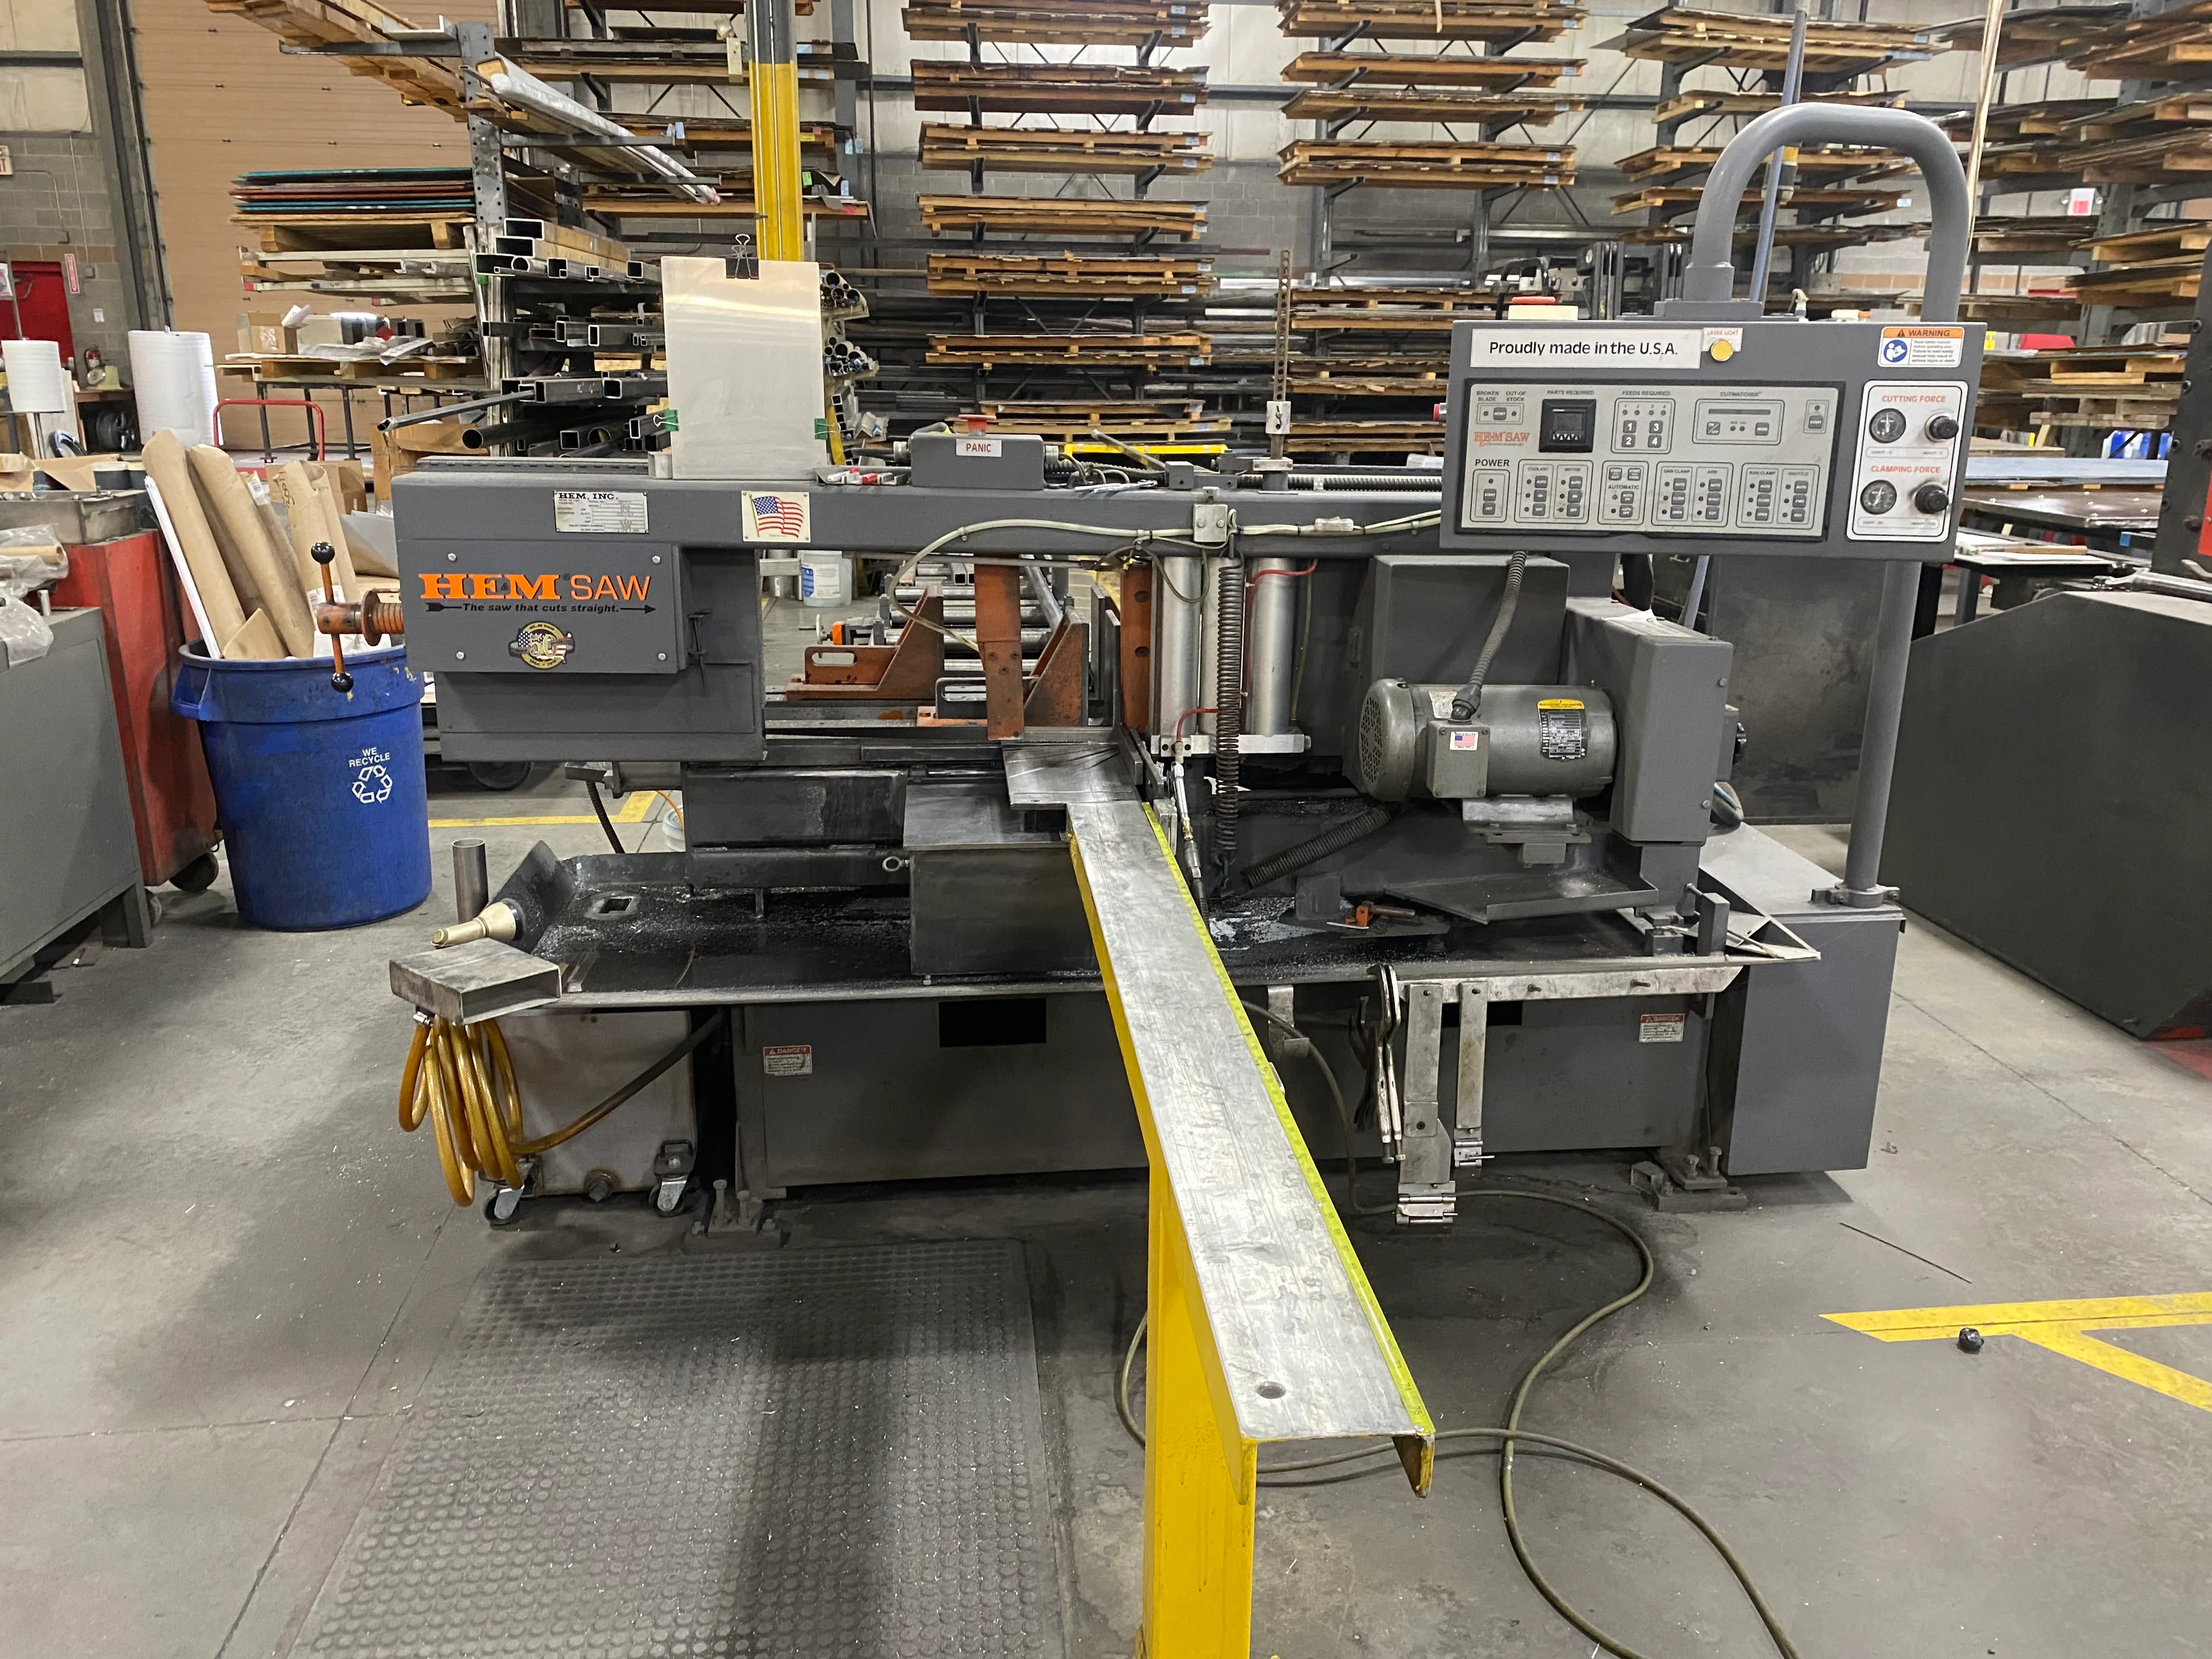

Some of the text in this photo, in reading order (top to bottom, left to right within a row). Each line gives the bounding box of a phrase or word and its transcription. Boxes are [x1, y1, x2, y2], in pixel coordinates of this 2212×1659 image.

[1489, 341, 1678, 356] Proudly made in the U.S.A.
[1628, 422, 1632, 431] 1
[1653, 423, 1660, 431] 3
[1505, 432, 1530, 442] SAW
[1626, 437, 1632, 445] 2
[966, 443, 991, 452] PANIC
[571, 575, 652, 600] SAW
[462, 603, 485, 612] The
[515, 603, 539, 612] that
[543, 604, 567, 612] cuts
[571, 603, 619, 614] straight.
[362, 747, 377, 757] WE
[349, 752, 391, 768] RECYCLE
